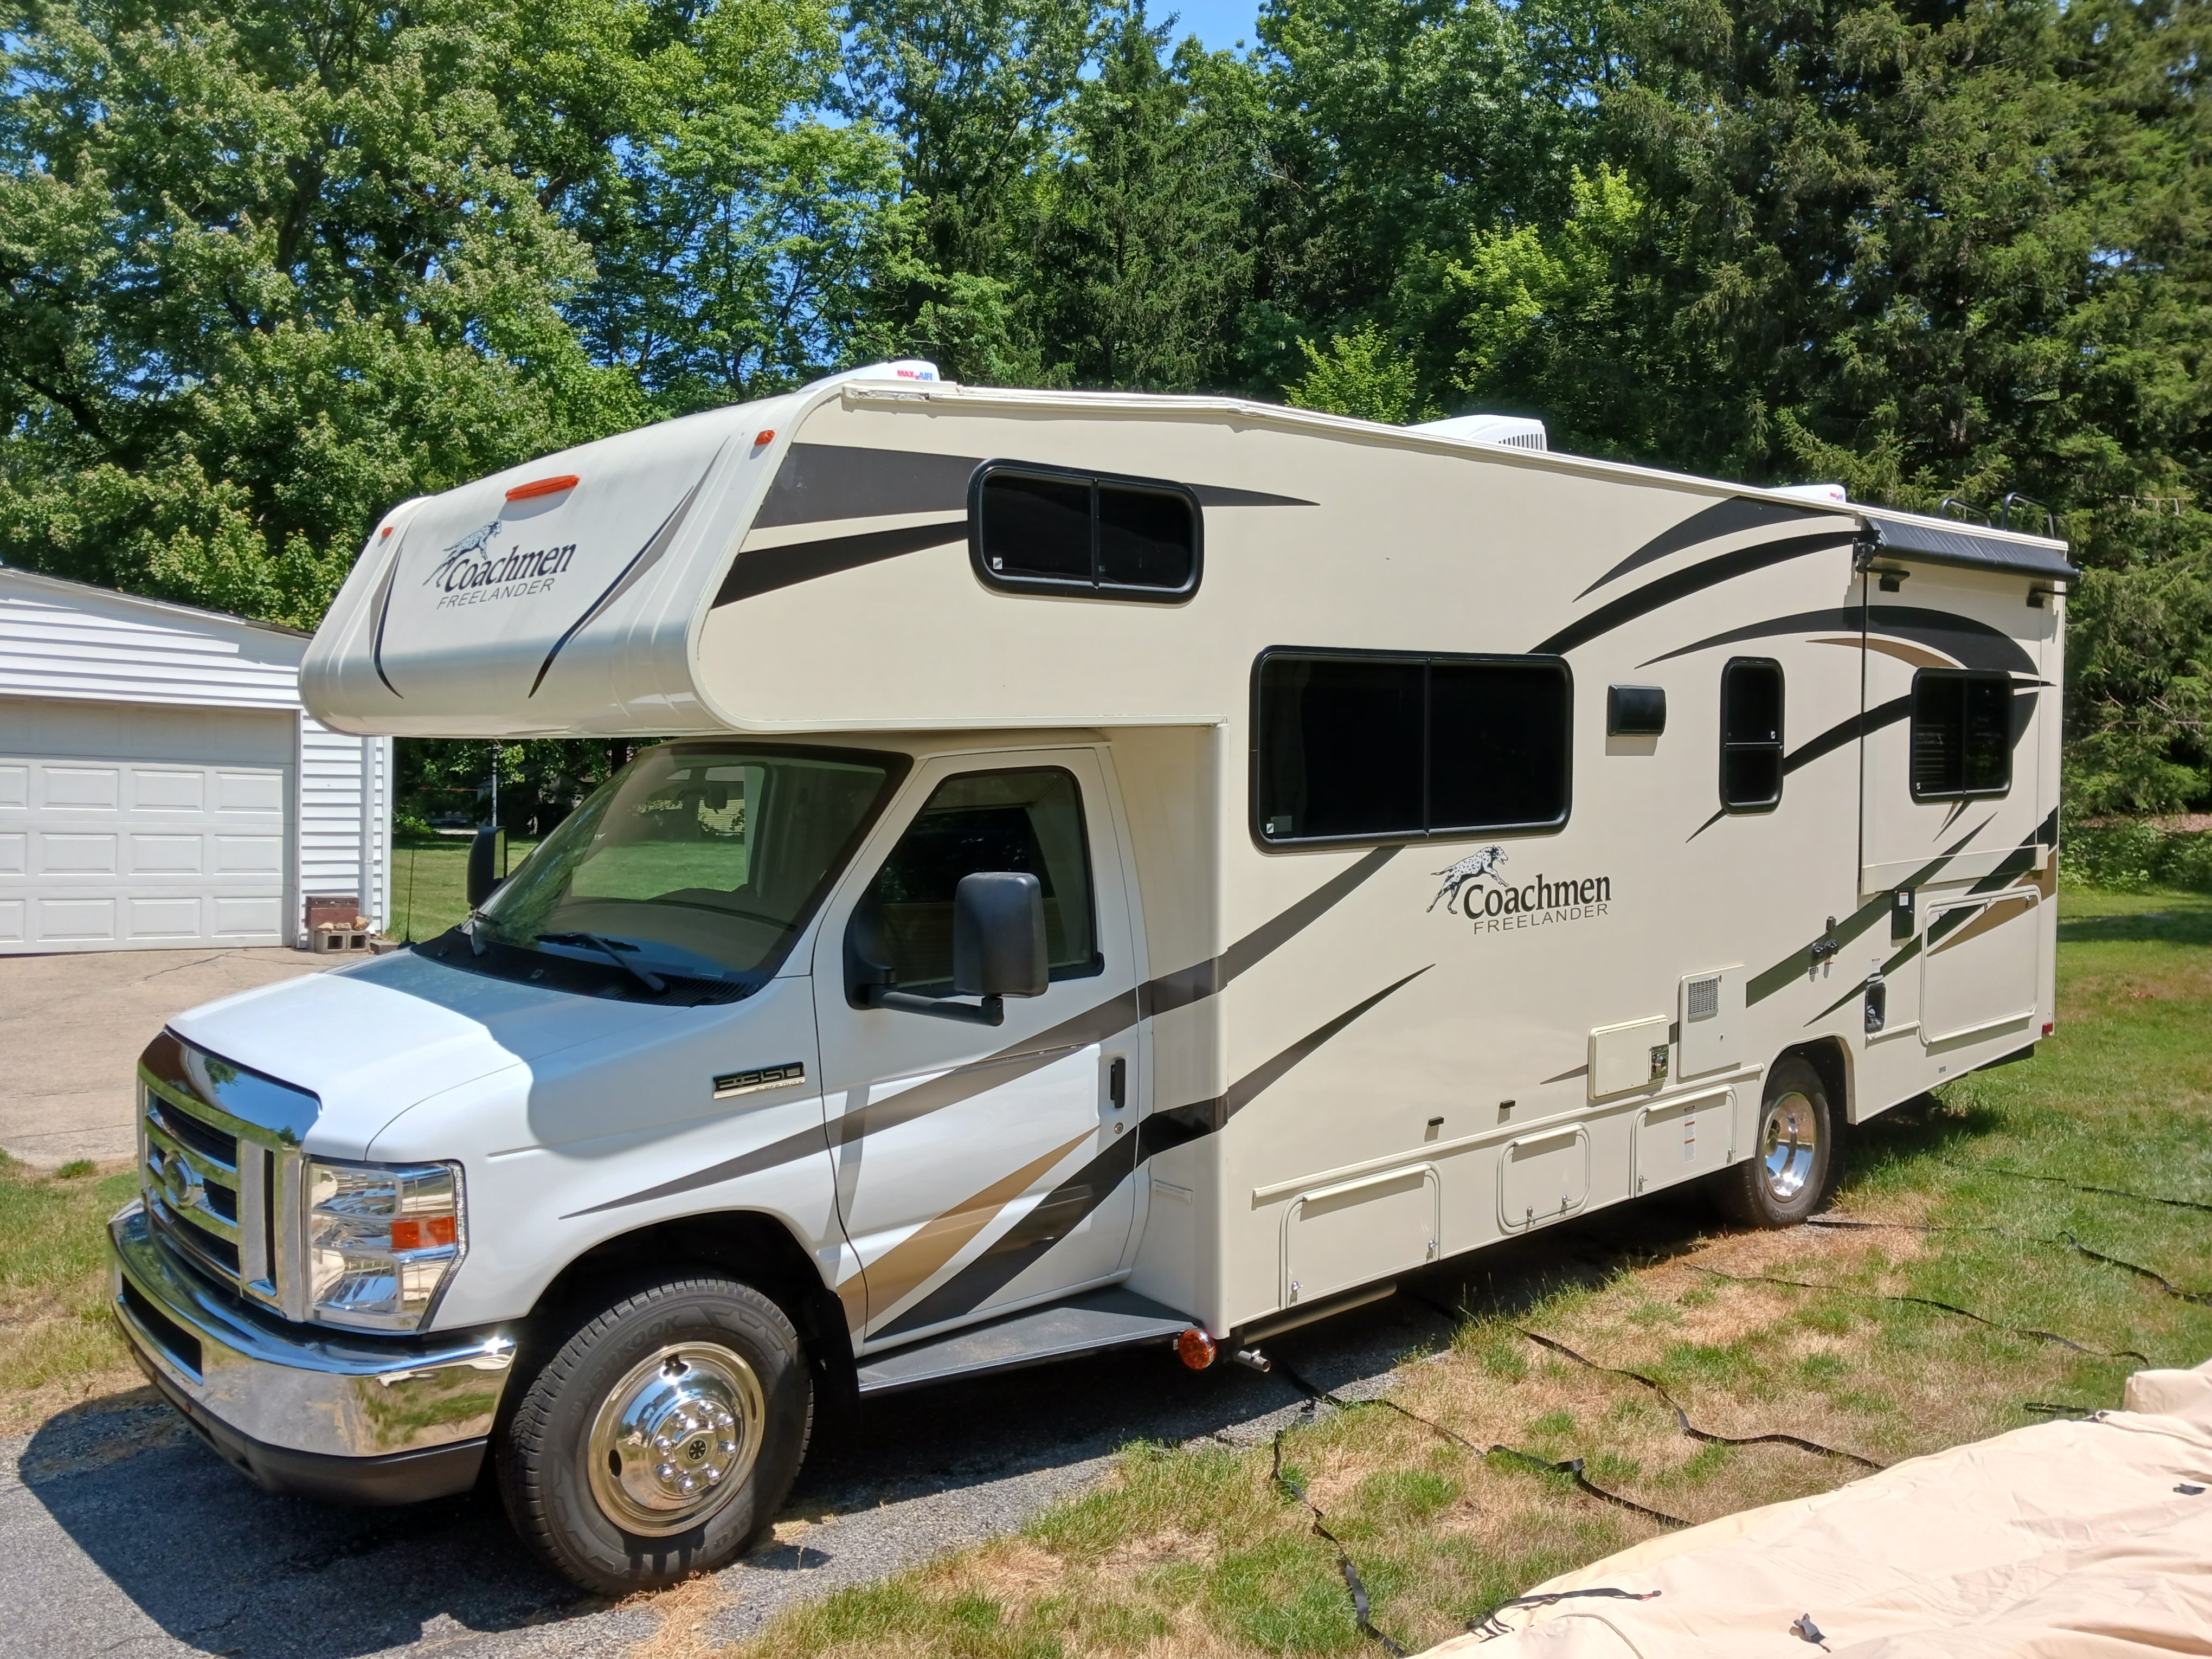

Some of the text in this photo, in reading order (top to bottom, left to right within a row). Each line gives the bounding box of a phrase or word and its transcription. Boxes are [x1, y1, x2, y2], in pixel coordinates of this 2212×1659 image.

[445, 543, 577, 593] Coachmen
[436, 578, 556, 610] FREELANDER
[1463, 873, 1612, 920] Coachmen
[1474, 903, 1609, 935] FREELANDER
[755, 1079, 803, 1092] SUPER DUTY
